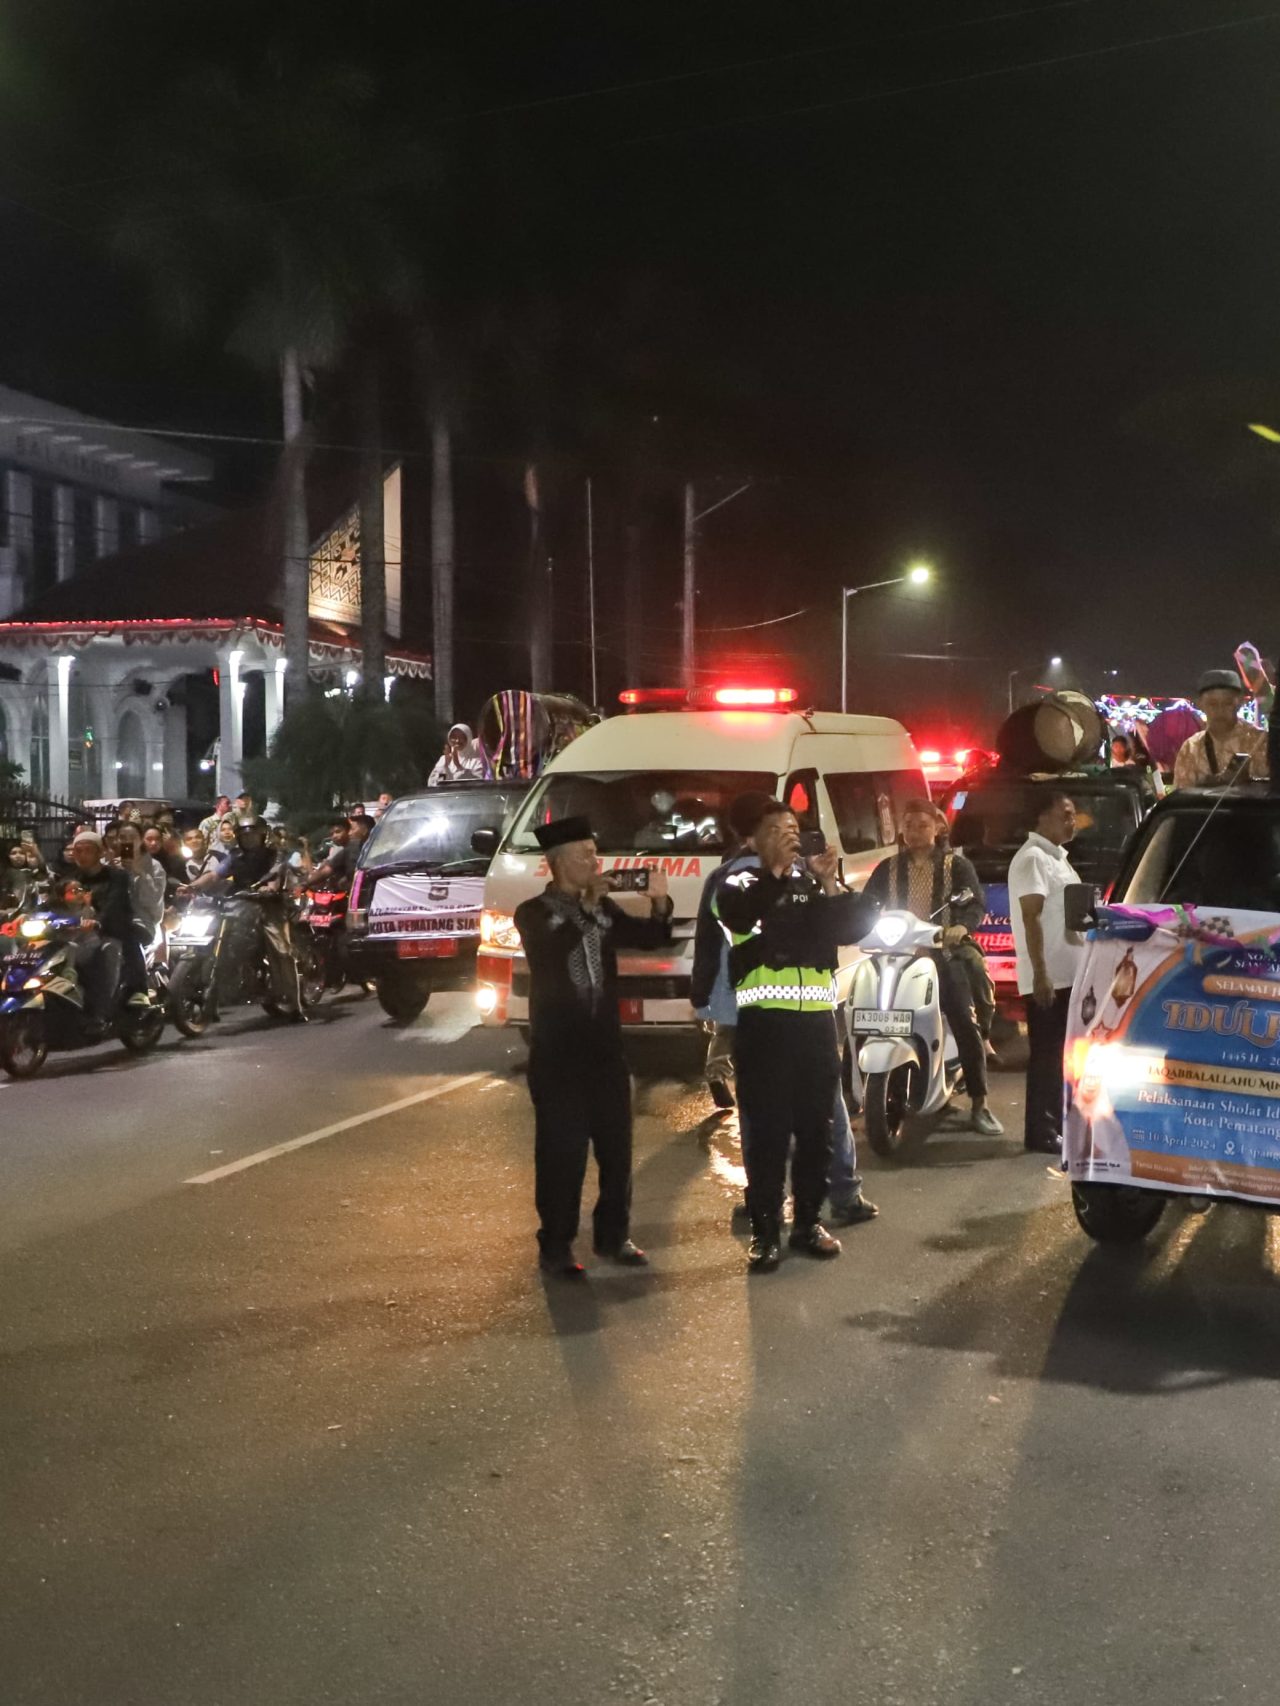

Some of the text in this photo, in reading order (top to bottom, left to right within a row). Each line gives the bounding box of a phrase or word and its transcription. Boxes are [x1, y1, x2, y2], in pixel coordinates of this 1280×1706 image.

[369, 921, 396, 934] KOTA
[398, 918, 454, 932] PEMATANG
[1215, 979, 1269, 995] SELAMAT
[1136, 1089, 1215, 1111] Pelaksanaan
[1220, 1100, 1262, 1118] Sholat
[1184, 1111, 1214, 1129] Kota
[1163, 1134, 1188, 1147] April
